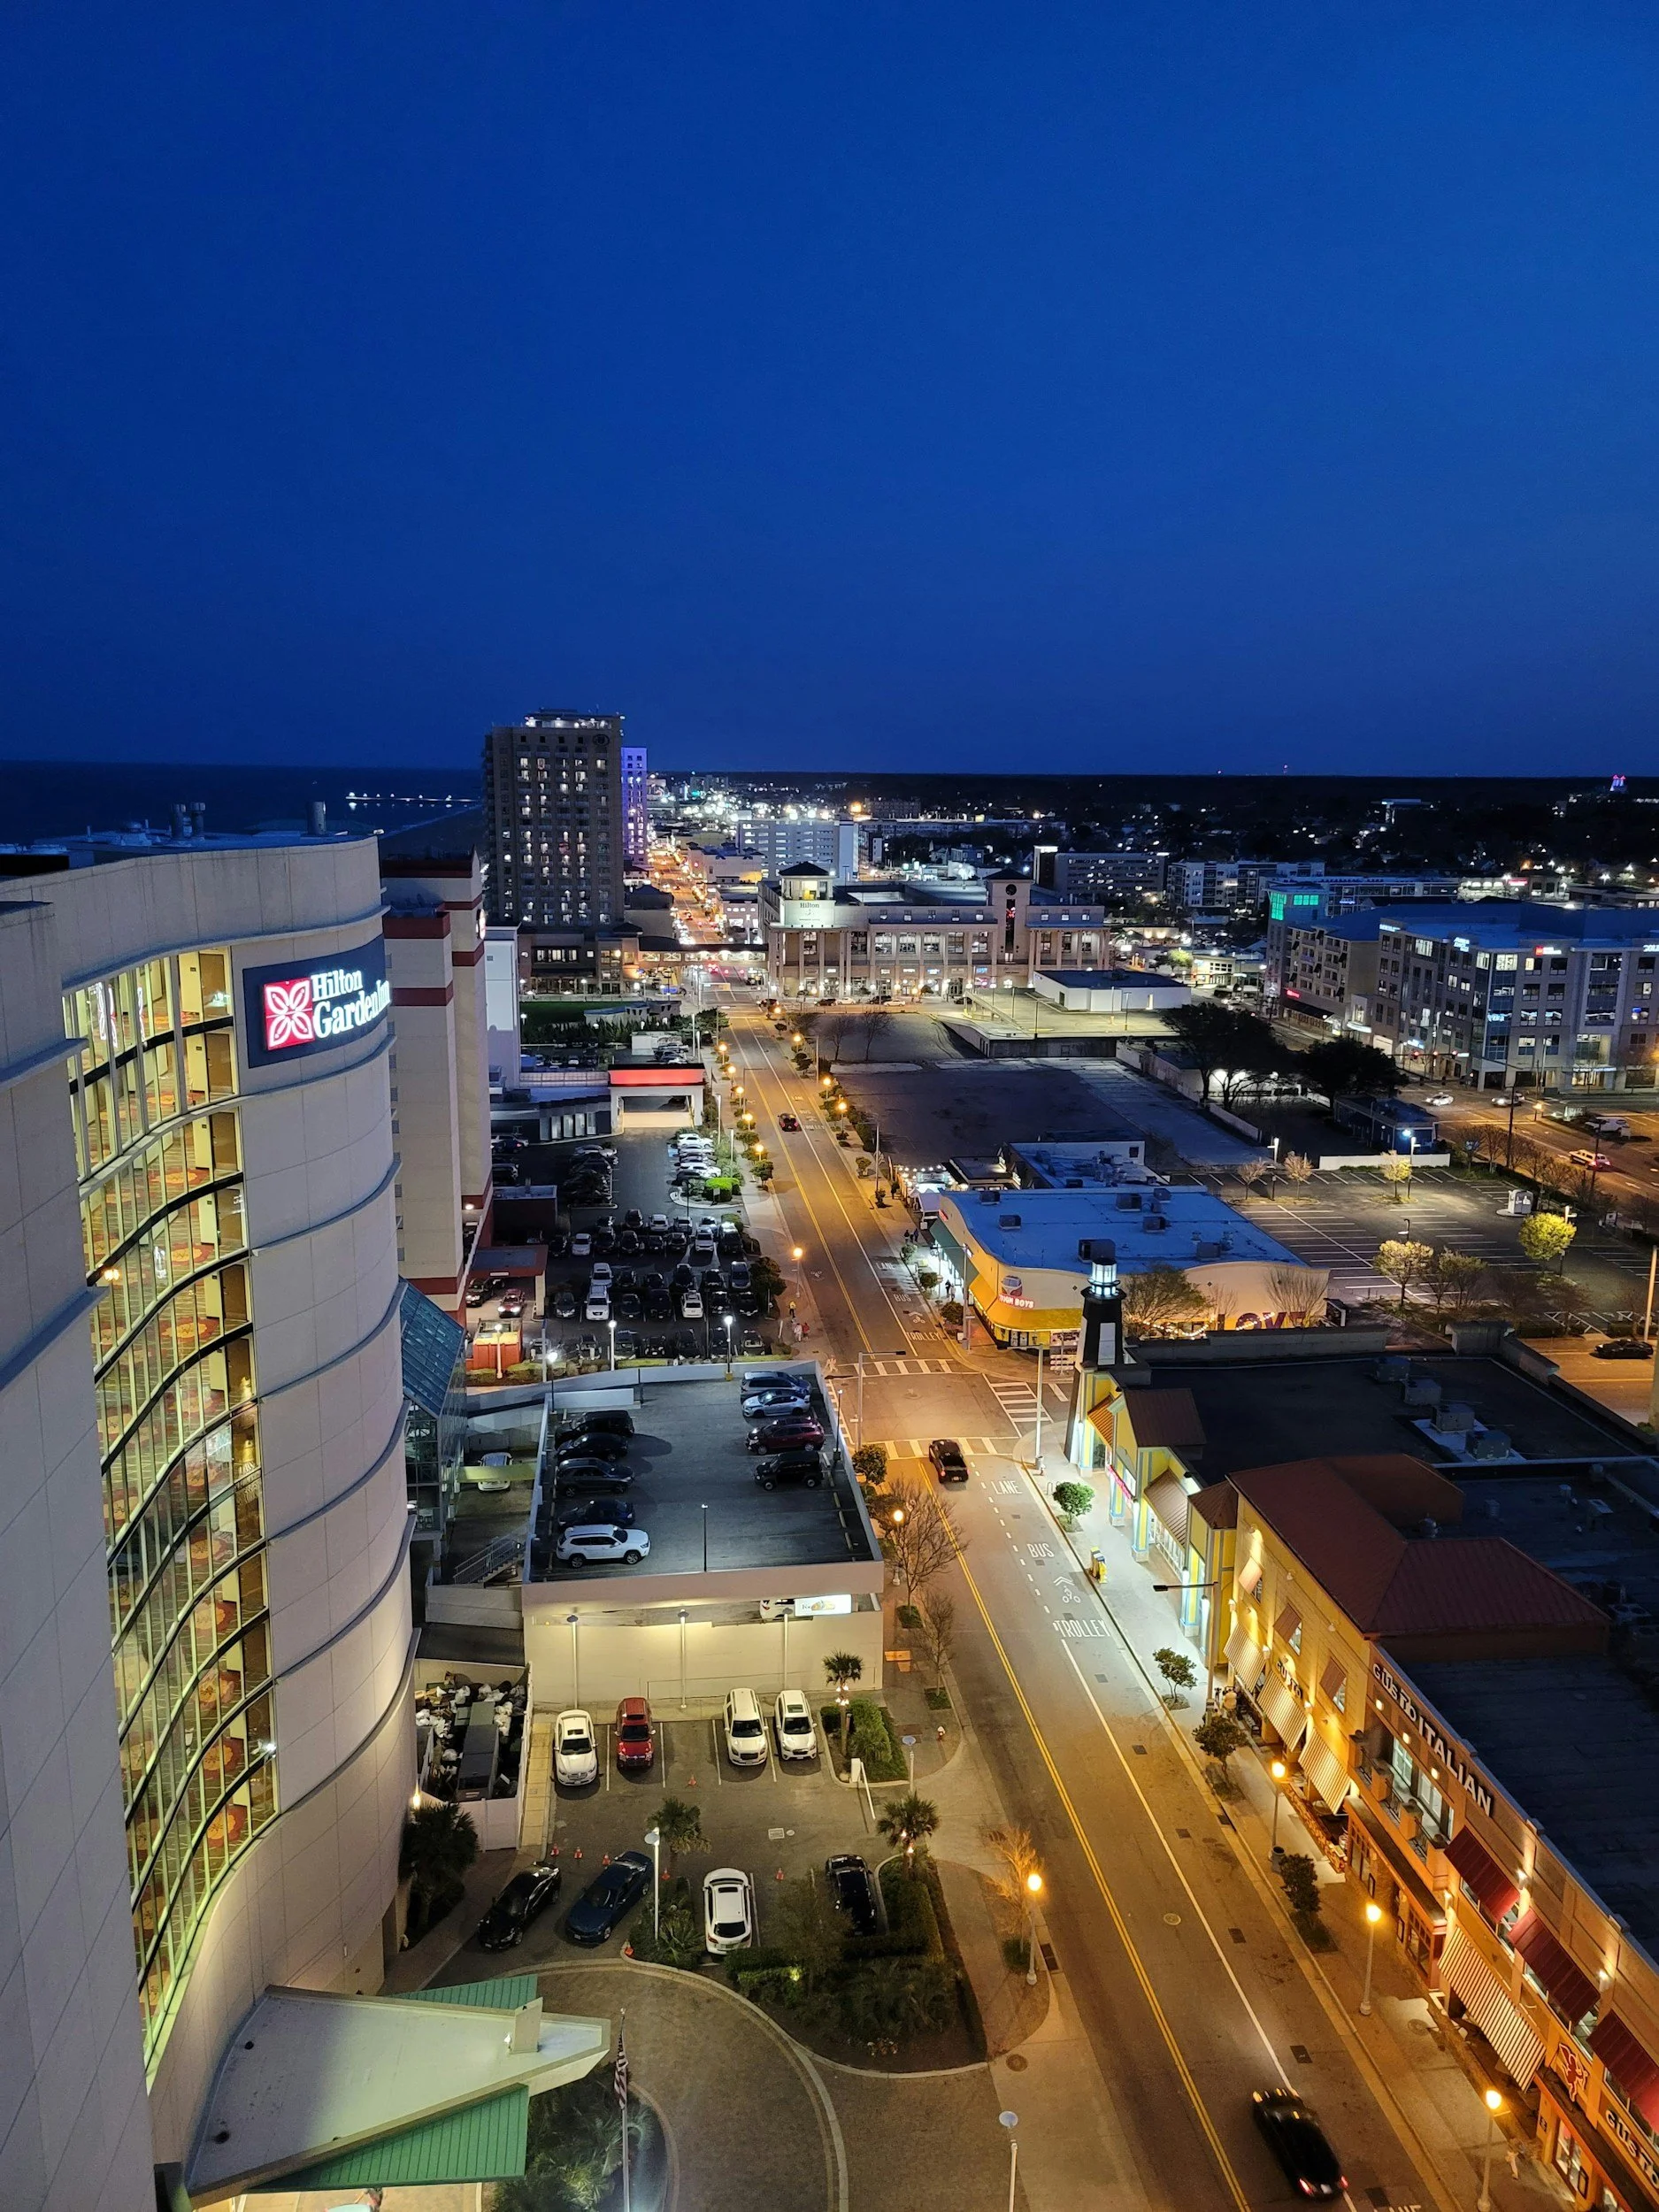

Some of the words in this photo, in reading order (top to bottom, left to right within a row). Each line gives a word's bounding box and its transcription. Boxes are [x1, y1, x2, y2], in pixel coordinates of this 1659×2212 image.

[311, 969, 363, 1001] Hilton
[312, 990, 379, 1039] Garden
[375, 979, 391, 1014] Inn
[893, 1294, 912, 1302] BUS
[1014, 1298, 1034, 1309] BOYS
[905, 1332, 941, 1340] TROLLEY
[991, 1480, 1023, 1494] LANE
[1026, 1543, 1054, 1558] BUS
[1055, 1619, 1110, 1637] TROLLEY
[1372, 1663, 1417, 1722] GUSTO
[1418, 1715, 1492, 1816] ITALIAN
[1605, 2108, 1659, 2190] GUSTO
